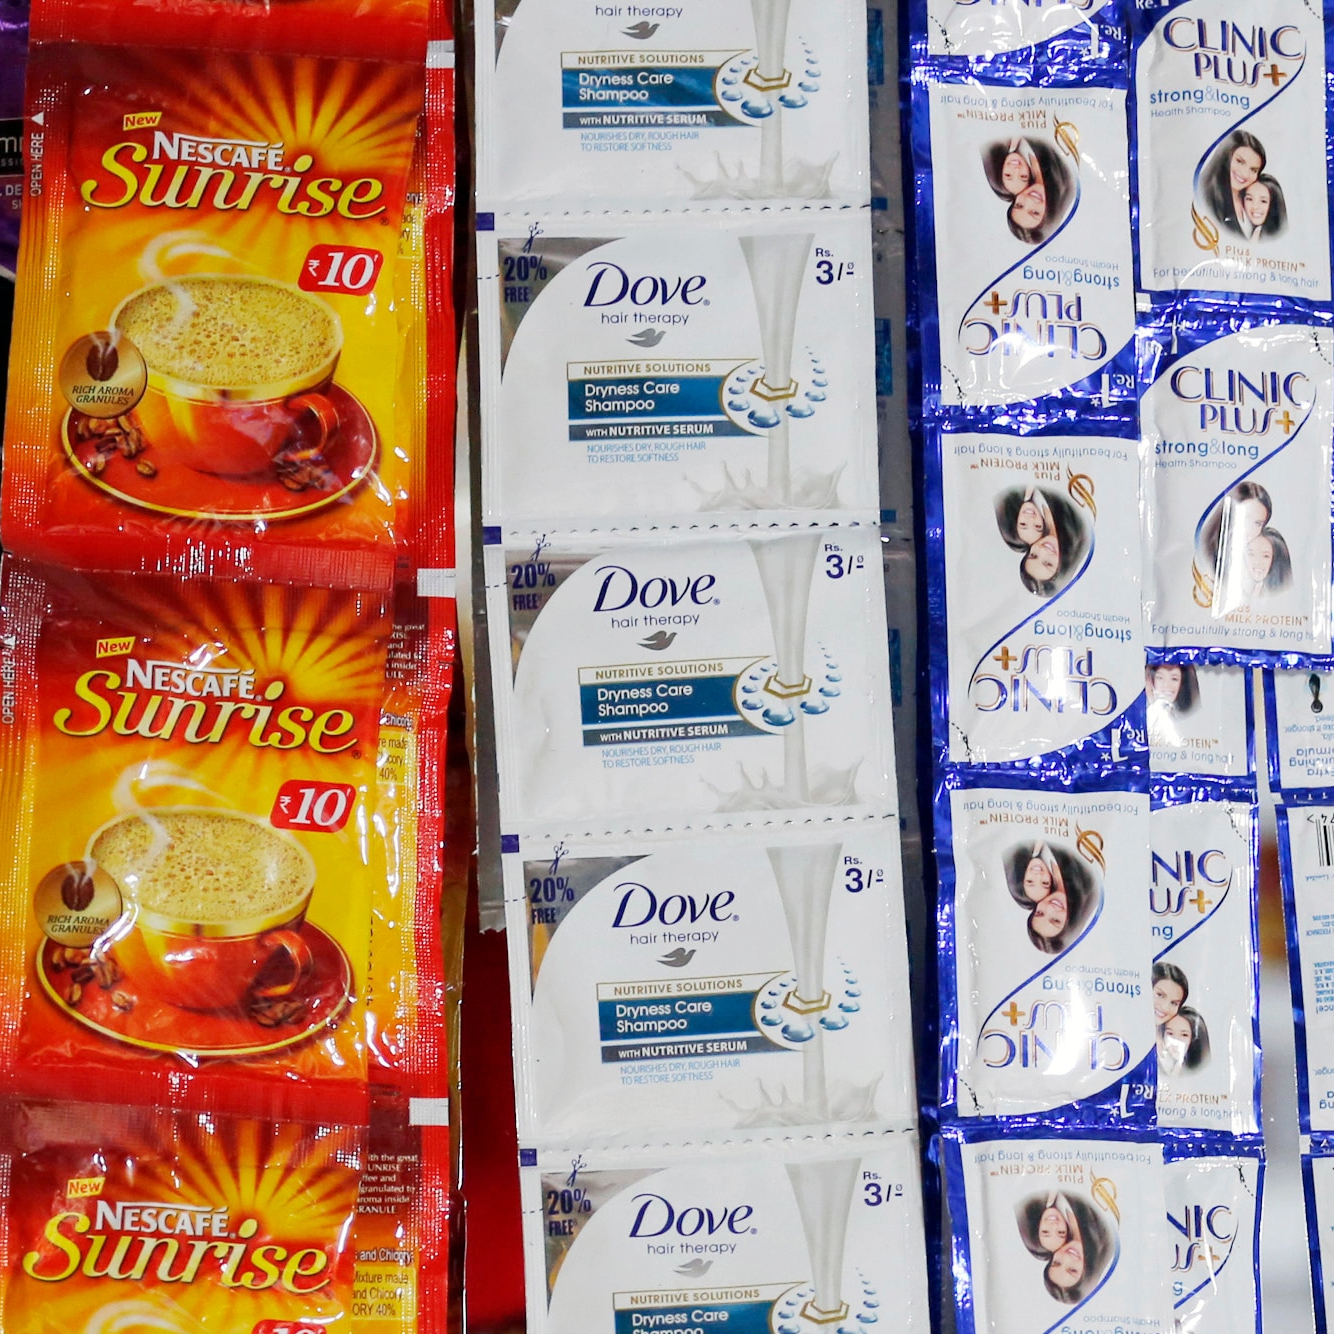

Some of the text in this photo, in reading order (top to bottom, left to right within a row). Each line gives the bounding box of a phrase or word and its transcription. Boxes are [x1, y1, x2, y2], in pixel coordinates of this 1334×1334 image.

[1164, 17, 1305, 60] CLINIC
[1151, 107, 1231, 118] Health Shampoo
[125, 114, 159, 129] New
[30, 132, 44, 197] OPEN HERE
[82, 143, 388, 219] Sunrise
[816, 249, 833, 258] Rs.
[504, 257, 547, 281] 20%
[584, 262, 705, 307] Dove
[1153, 267, 1319, 288] For beautifully strong & long hair
[602, 312, 689, 326] hair therapy
[584, 363, 711, 374] NUTRITIVE SOLUTIONS
[73, 385, 134, 397] RICH AROMA
[585, 382, 680, 397] Dryness Care
[76, 394, 129, 406] GRANULES
[585, 398, 654, 413] Shampoo
[586, 424, 713, 437] WITH NUTRITIVE SERUM
[594, 565, 715, 612] Dove
[612, 613, 700, 628] hair therapy
[97, 640, 131, 654] New
[974, 676, 1117, 714] CLINIC
[54, 671, 358, 753] Sunrise
[602, 748, 648, 758] NOURISHES
[670, 744, 699, 755] ROUGH
[702, 743, 721, 752] HAIR
[603, 755, 694, 768] TO RESTORE SOFTNESS
[613, 883, 734, 928] Dove
[48, 915, 71, 925] RICH
[69, 1180, 100, 1195] New
[630, 1194, 753, 1238] Dove
[23, 1213, 333, 1293] Sunrise
